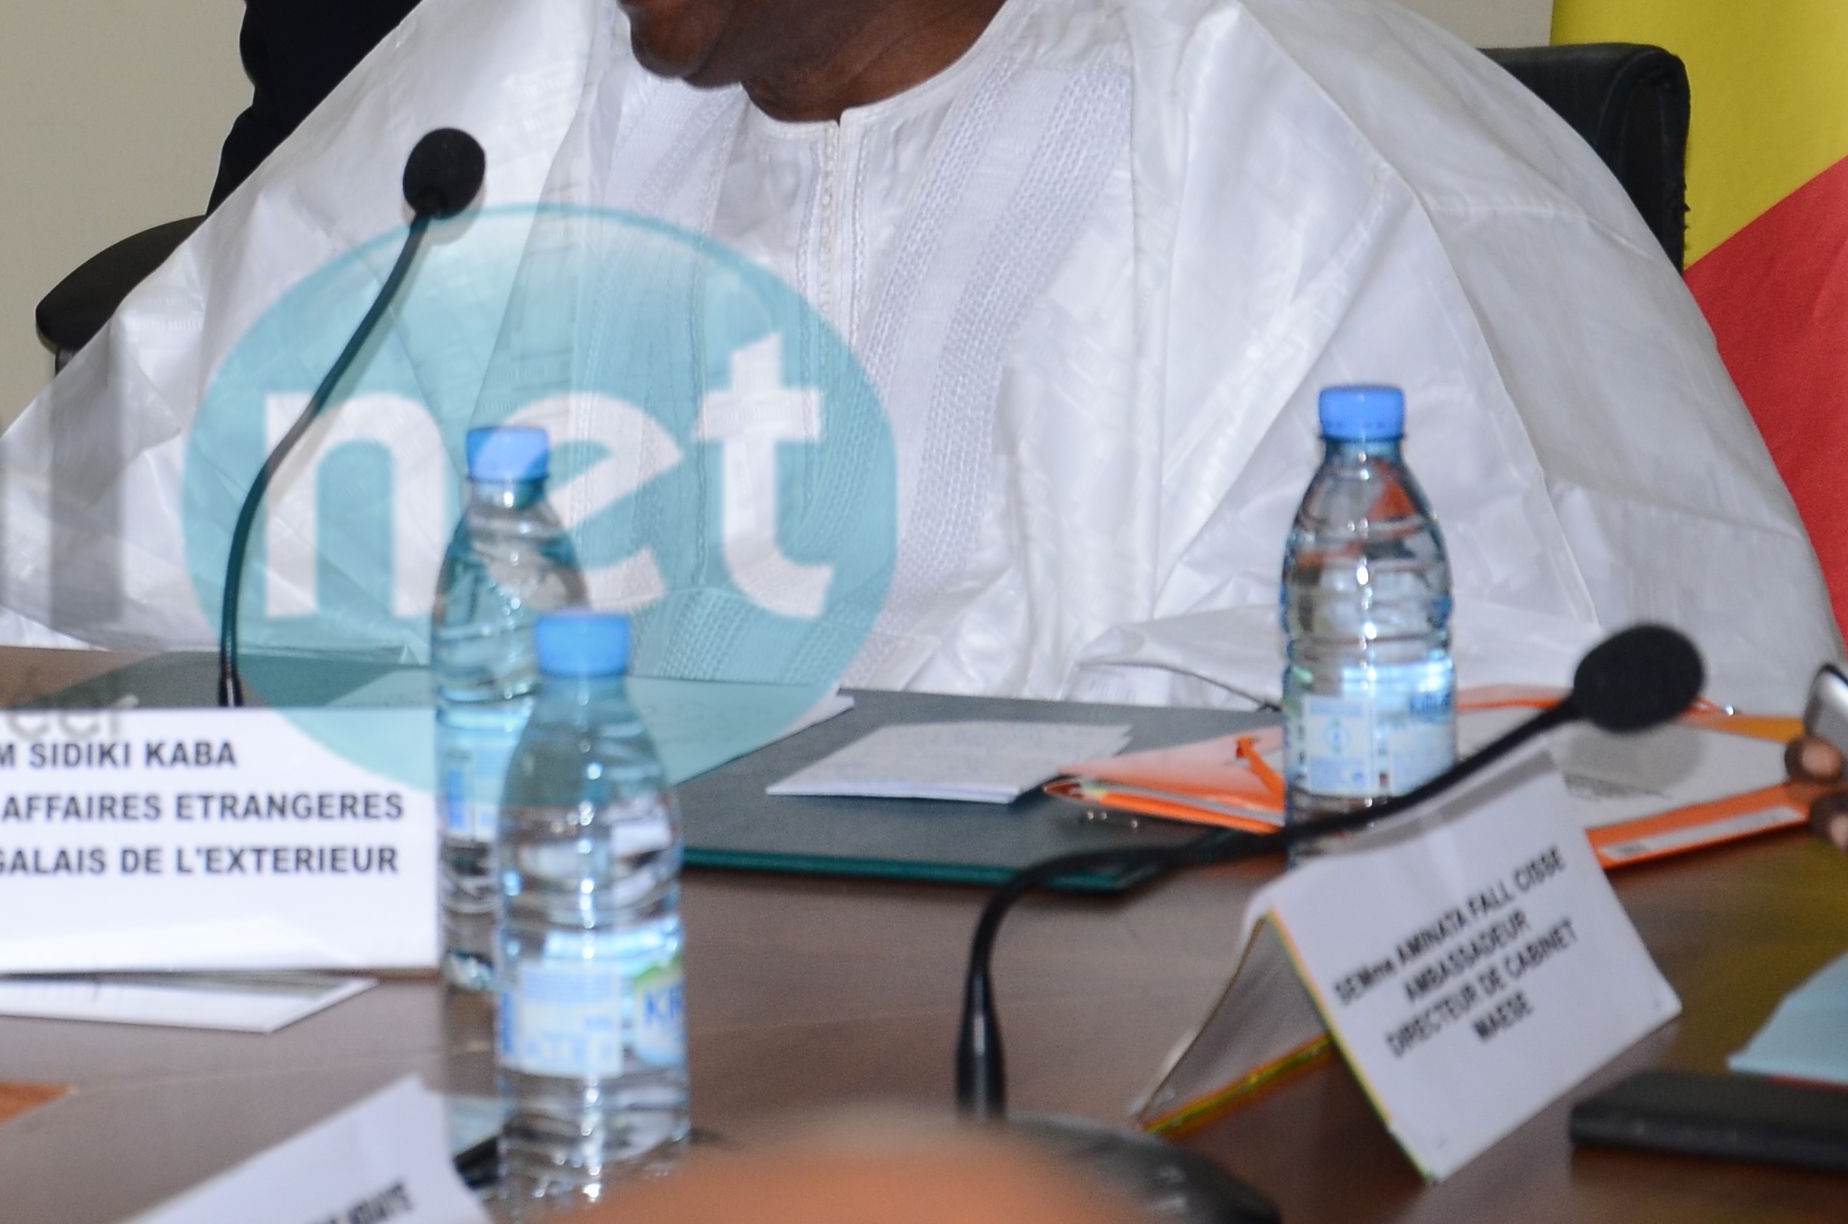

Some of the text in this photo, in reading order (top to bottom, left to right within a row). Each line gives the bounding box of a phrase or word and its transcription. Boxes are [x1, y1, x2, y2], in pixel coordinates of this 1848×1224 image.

[29, 741, 132, 770] SIDIKI
[143, 739, 238, 769] KABA
[1, 793, 163, 823] AFFAIRES
[174, 791, 405, 823] ETRANGERES
[119, 846, 162, 876] DE
[174, 845, 400, 876] L'EXTERIEUR
[1395, 906, 1468, 966] AMINATA
[1466, 880, 1514, 917] FALL
[1514, 846, 1564, 892] CISSE
[1386, 915, 1578, 1057] DIRECTEUR DE CABINET
[1406, 910, 1528, 1001] AMBASSADEUR
